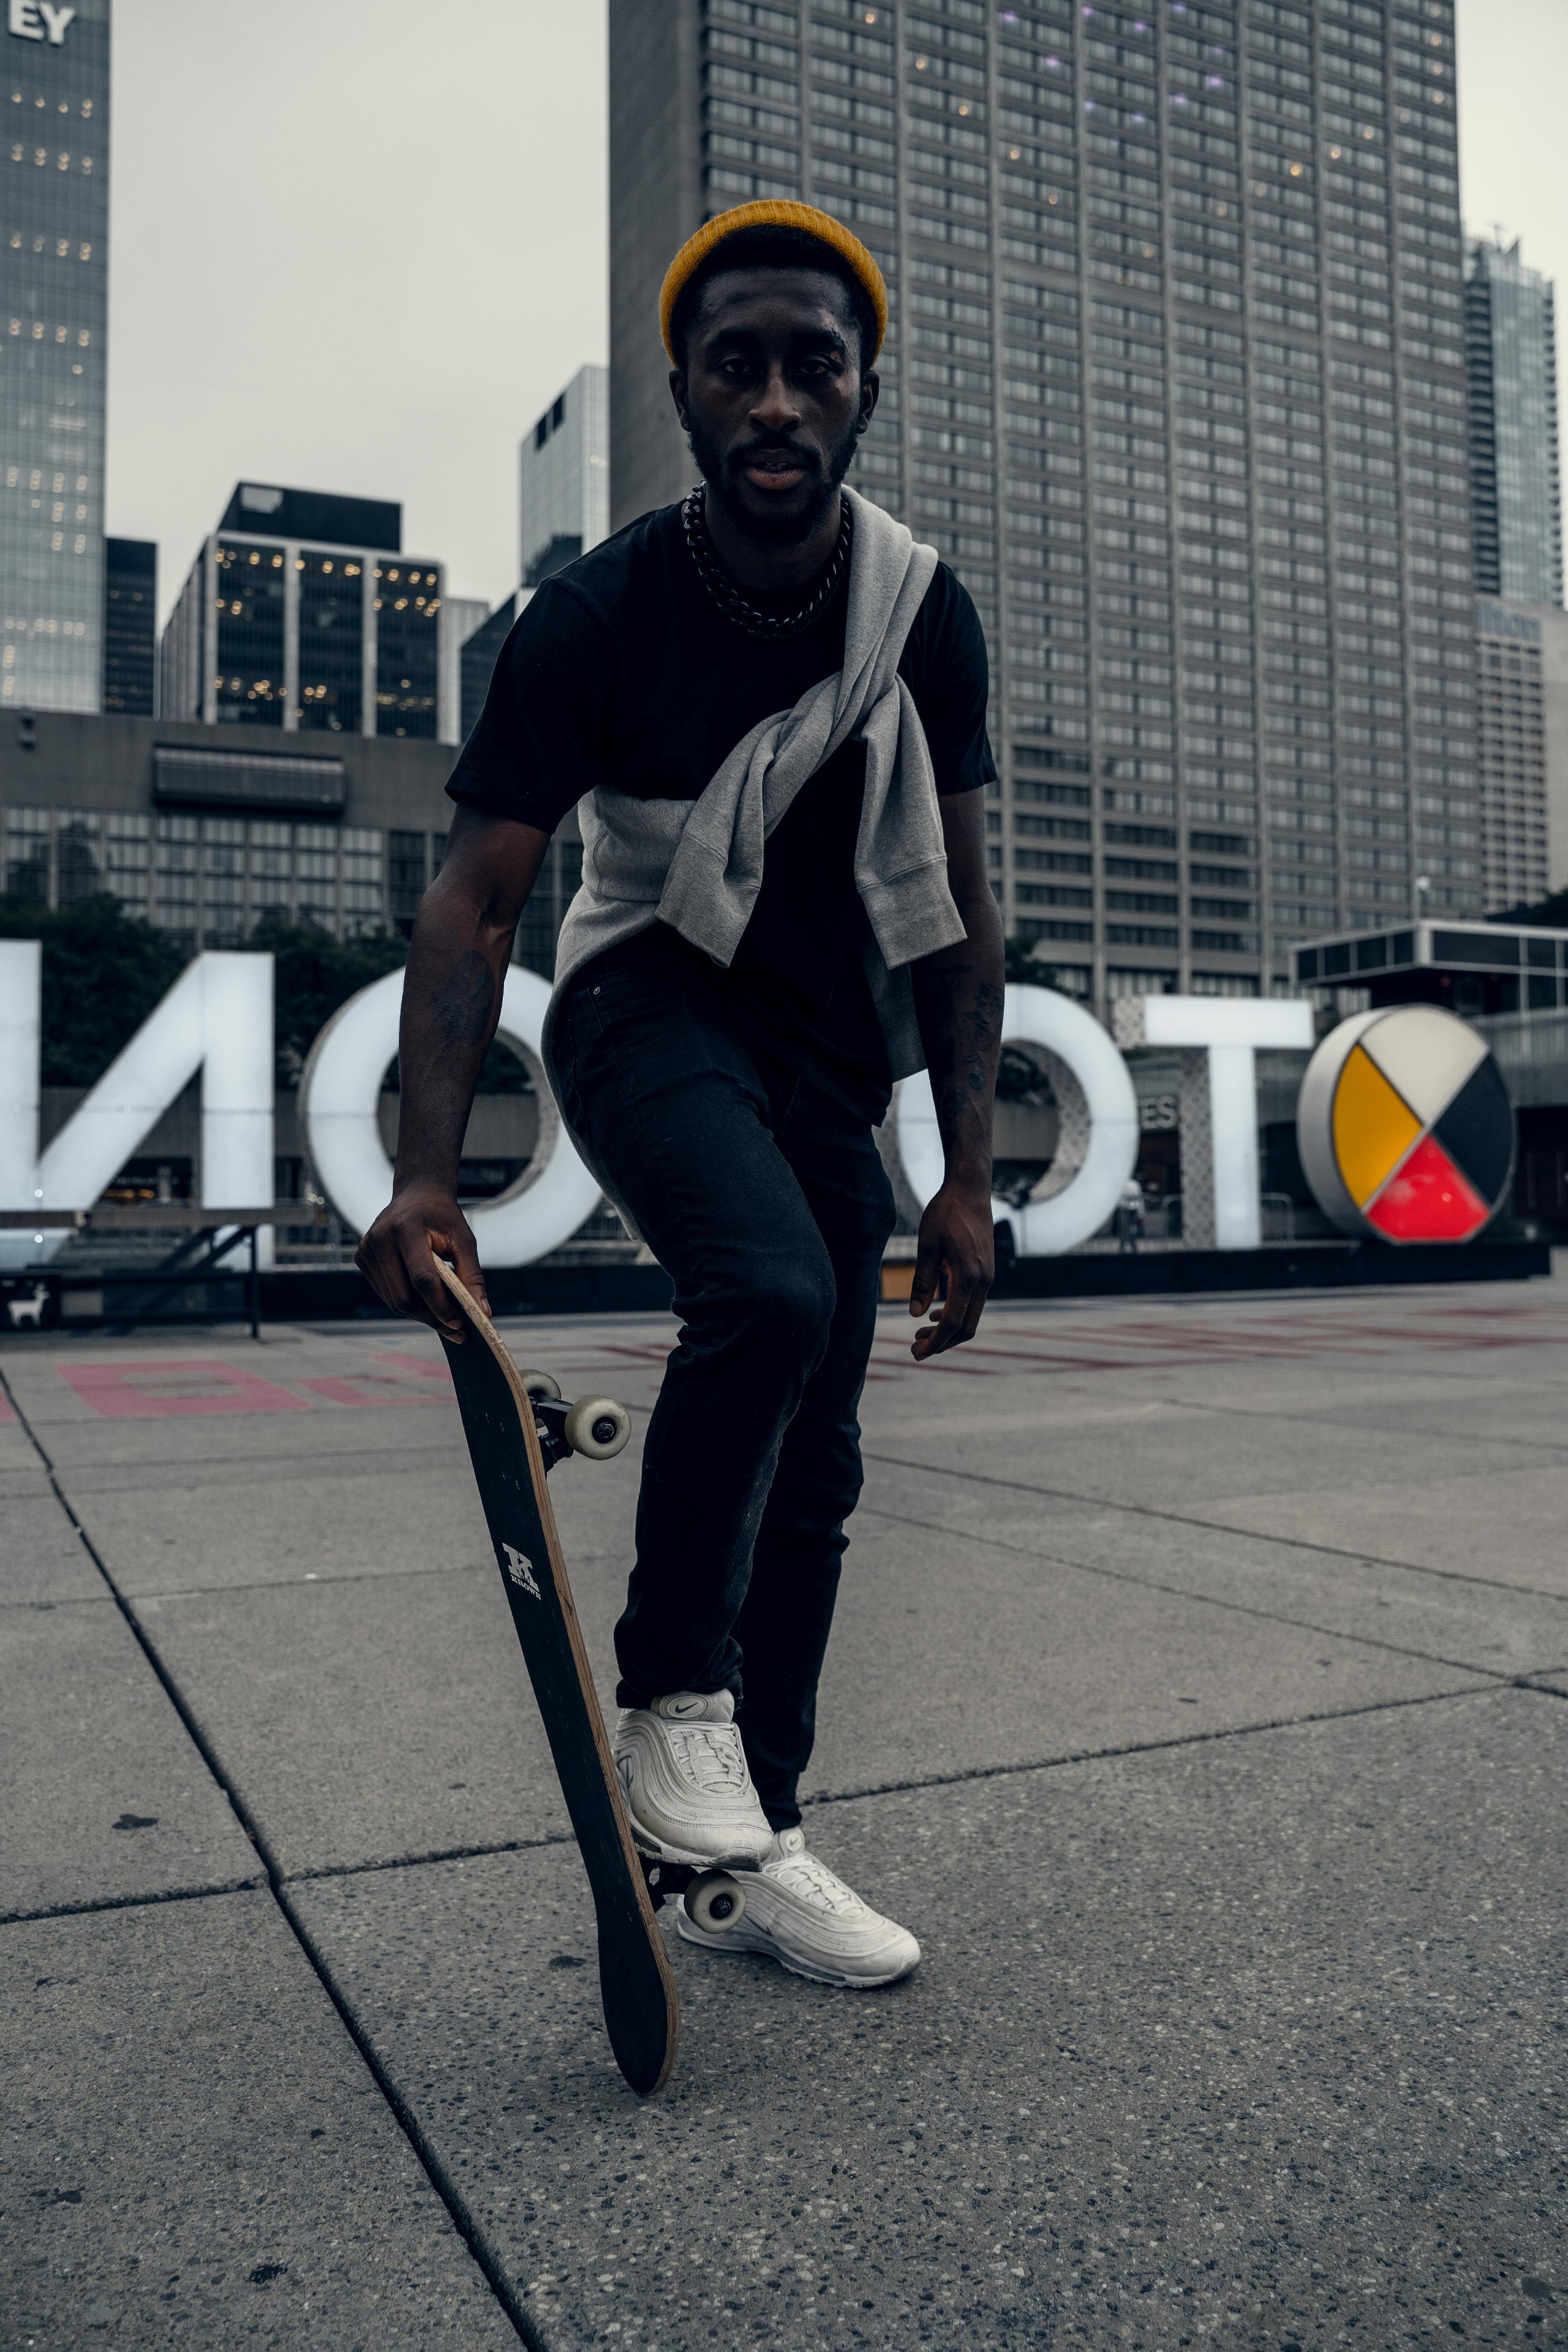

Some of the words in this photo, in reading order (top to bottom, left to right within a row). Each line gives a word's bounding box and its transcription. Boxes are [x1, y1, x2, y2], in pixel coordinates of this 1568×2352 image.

[9, 0, 75, 46] EY
[1138, 1094, 1178, 1129] ES
[510, 1574, 541, 1600] KROWN
